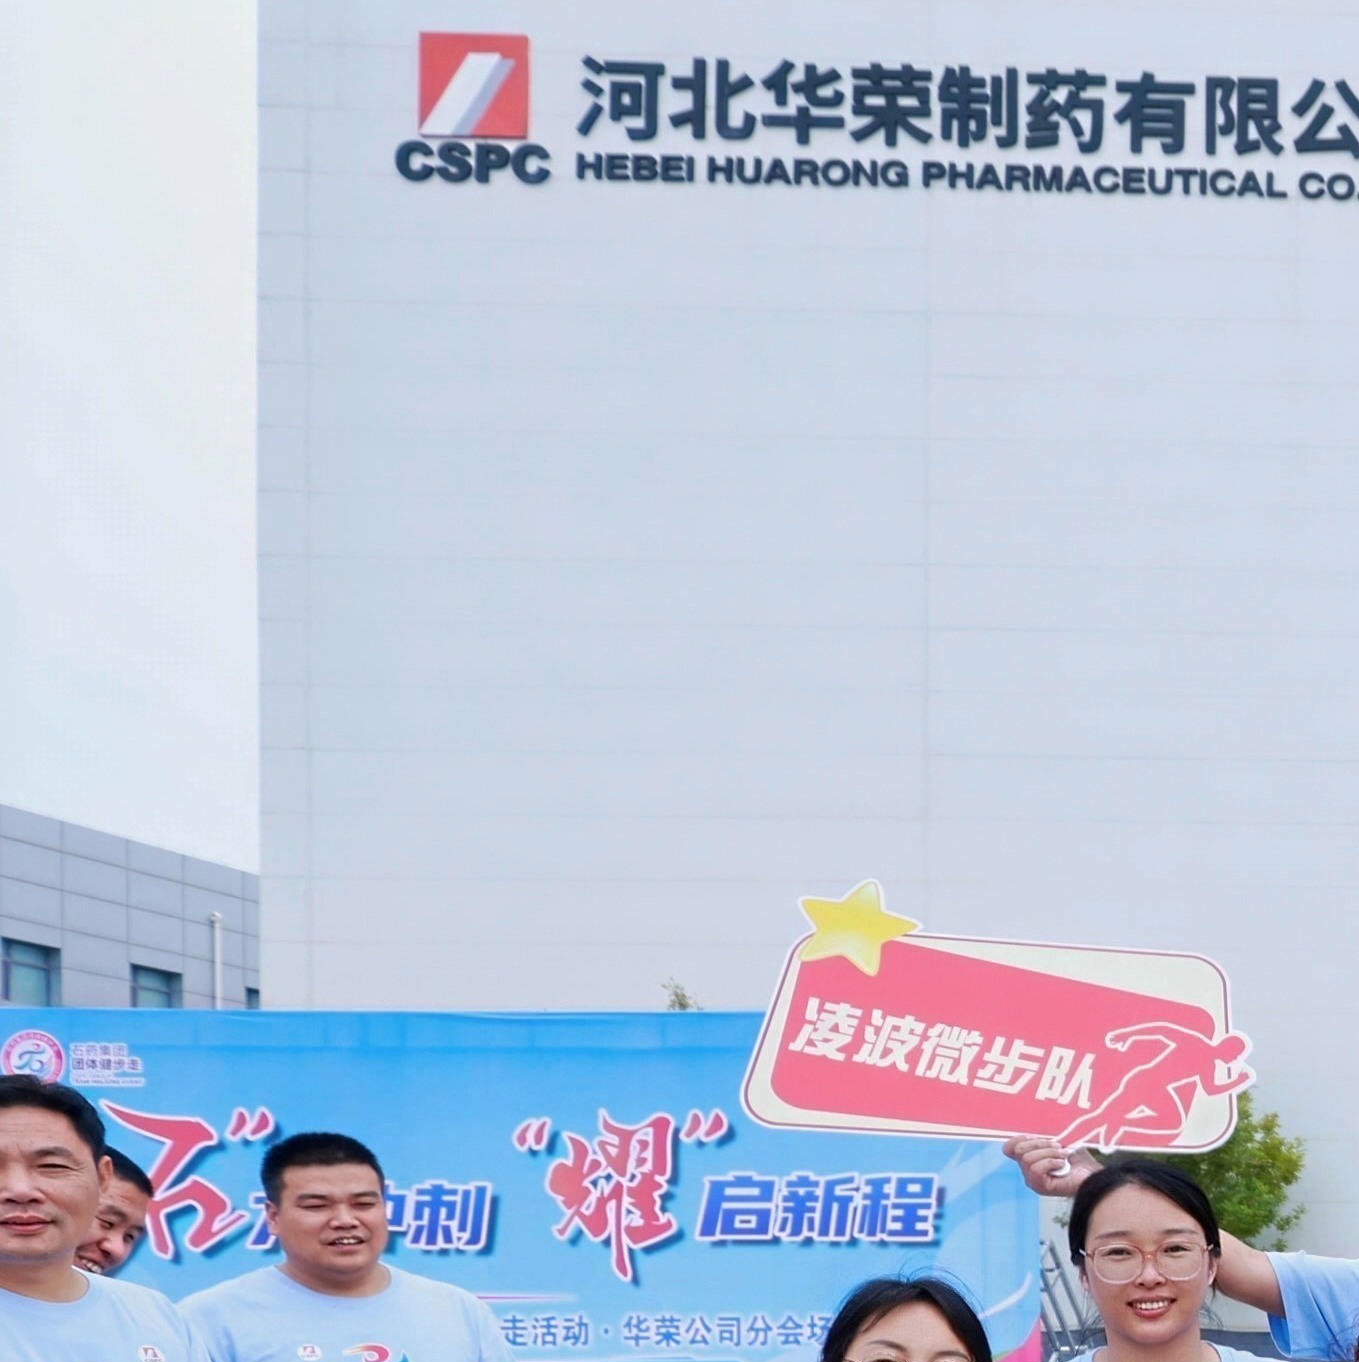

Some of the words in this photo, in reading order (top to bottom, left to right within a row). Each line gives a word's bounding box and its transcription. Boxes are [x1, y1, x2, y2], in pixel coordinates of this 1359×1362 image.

[394, 140, 551, 185] CSPC
[576, 152, 695, 183] HEBEI
[707, 156, 909, 188] HUARONG
[922, 161, 1289, 199] PHARMACEUTICAL
[788, 996, 1097, 1109] 凌波微步队
